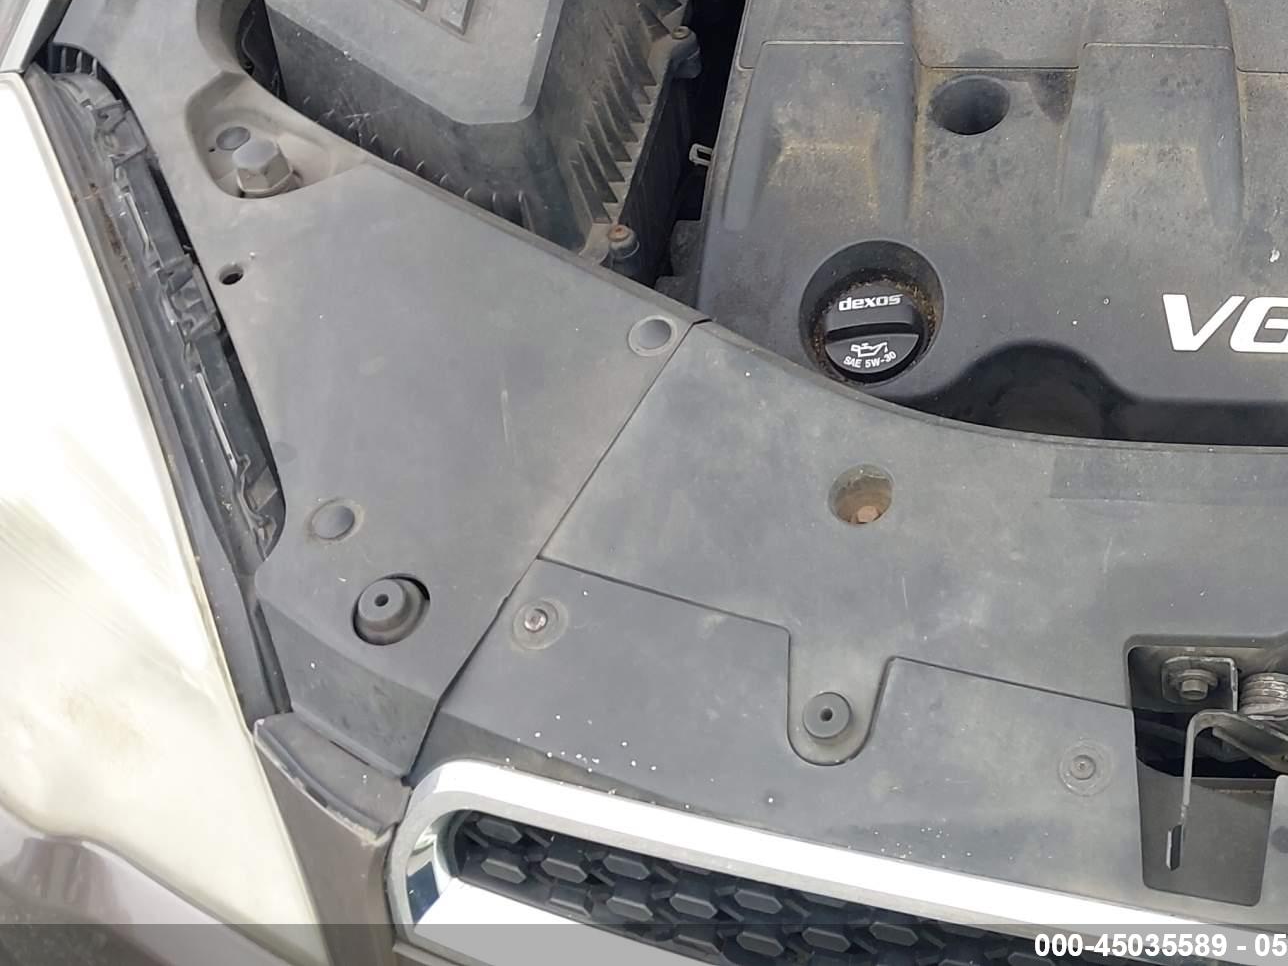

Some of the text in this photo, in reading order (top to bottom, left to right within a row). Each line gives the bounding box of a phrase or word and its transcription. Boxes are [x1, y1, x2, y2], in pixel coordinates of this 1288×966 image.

[838, 293, 904, 311] dexos
[843, 350, 897, 369] SAE 5W-30
